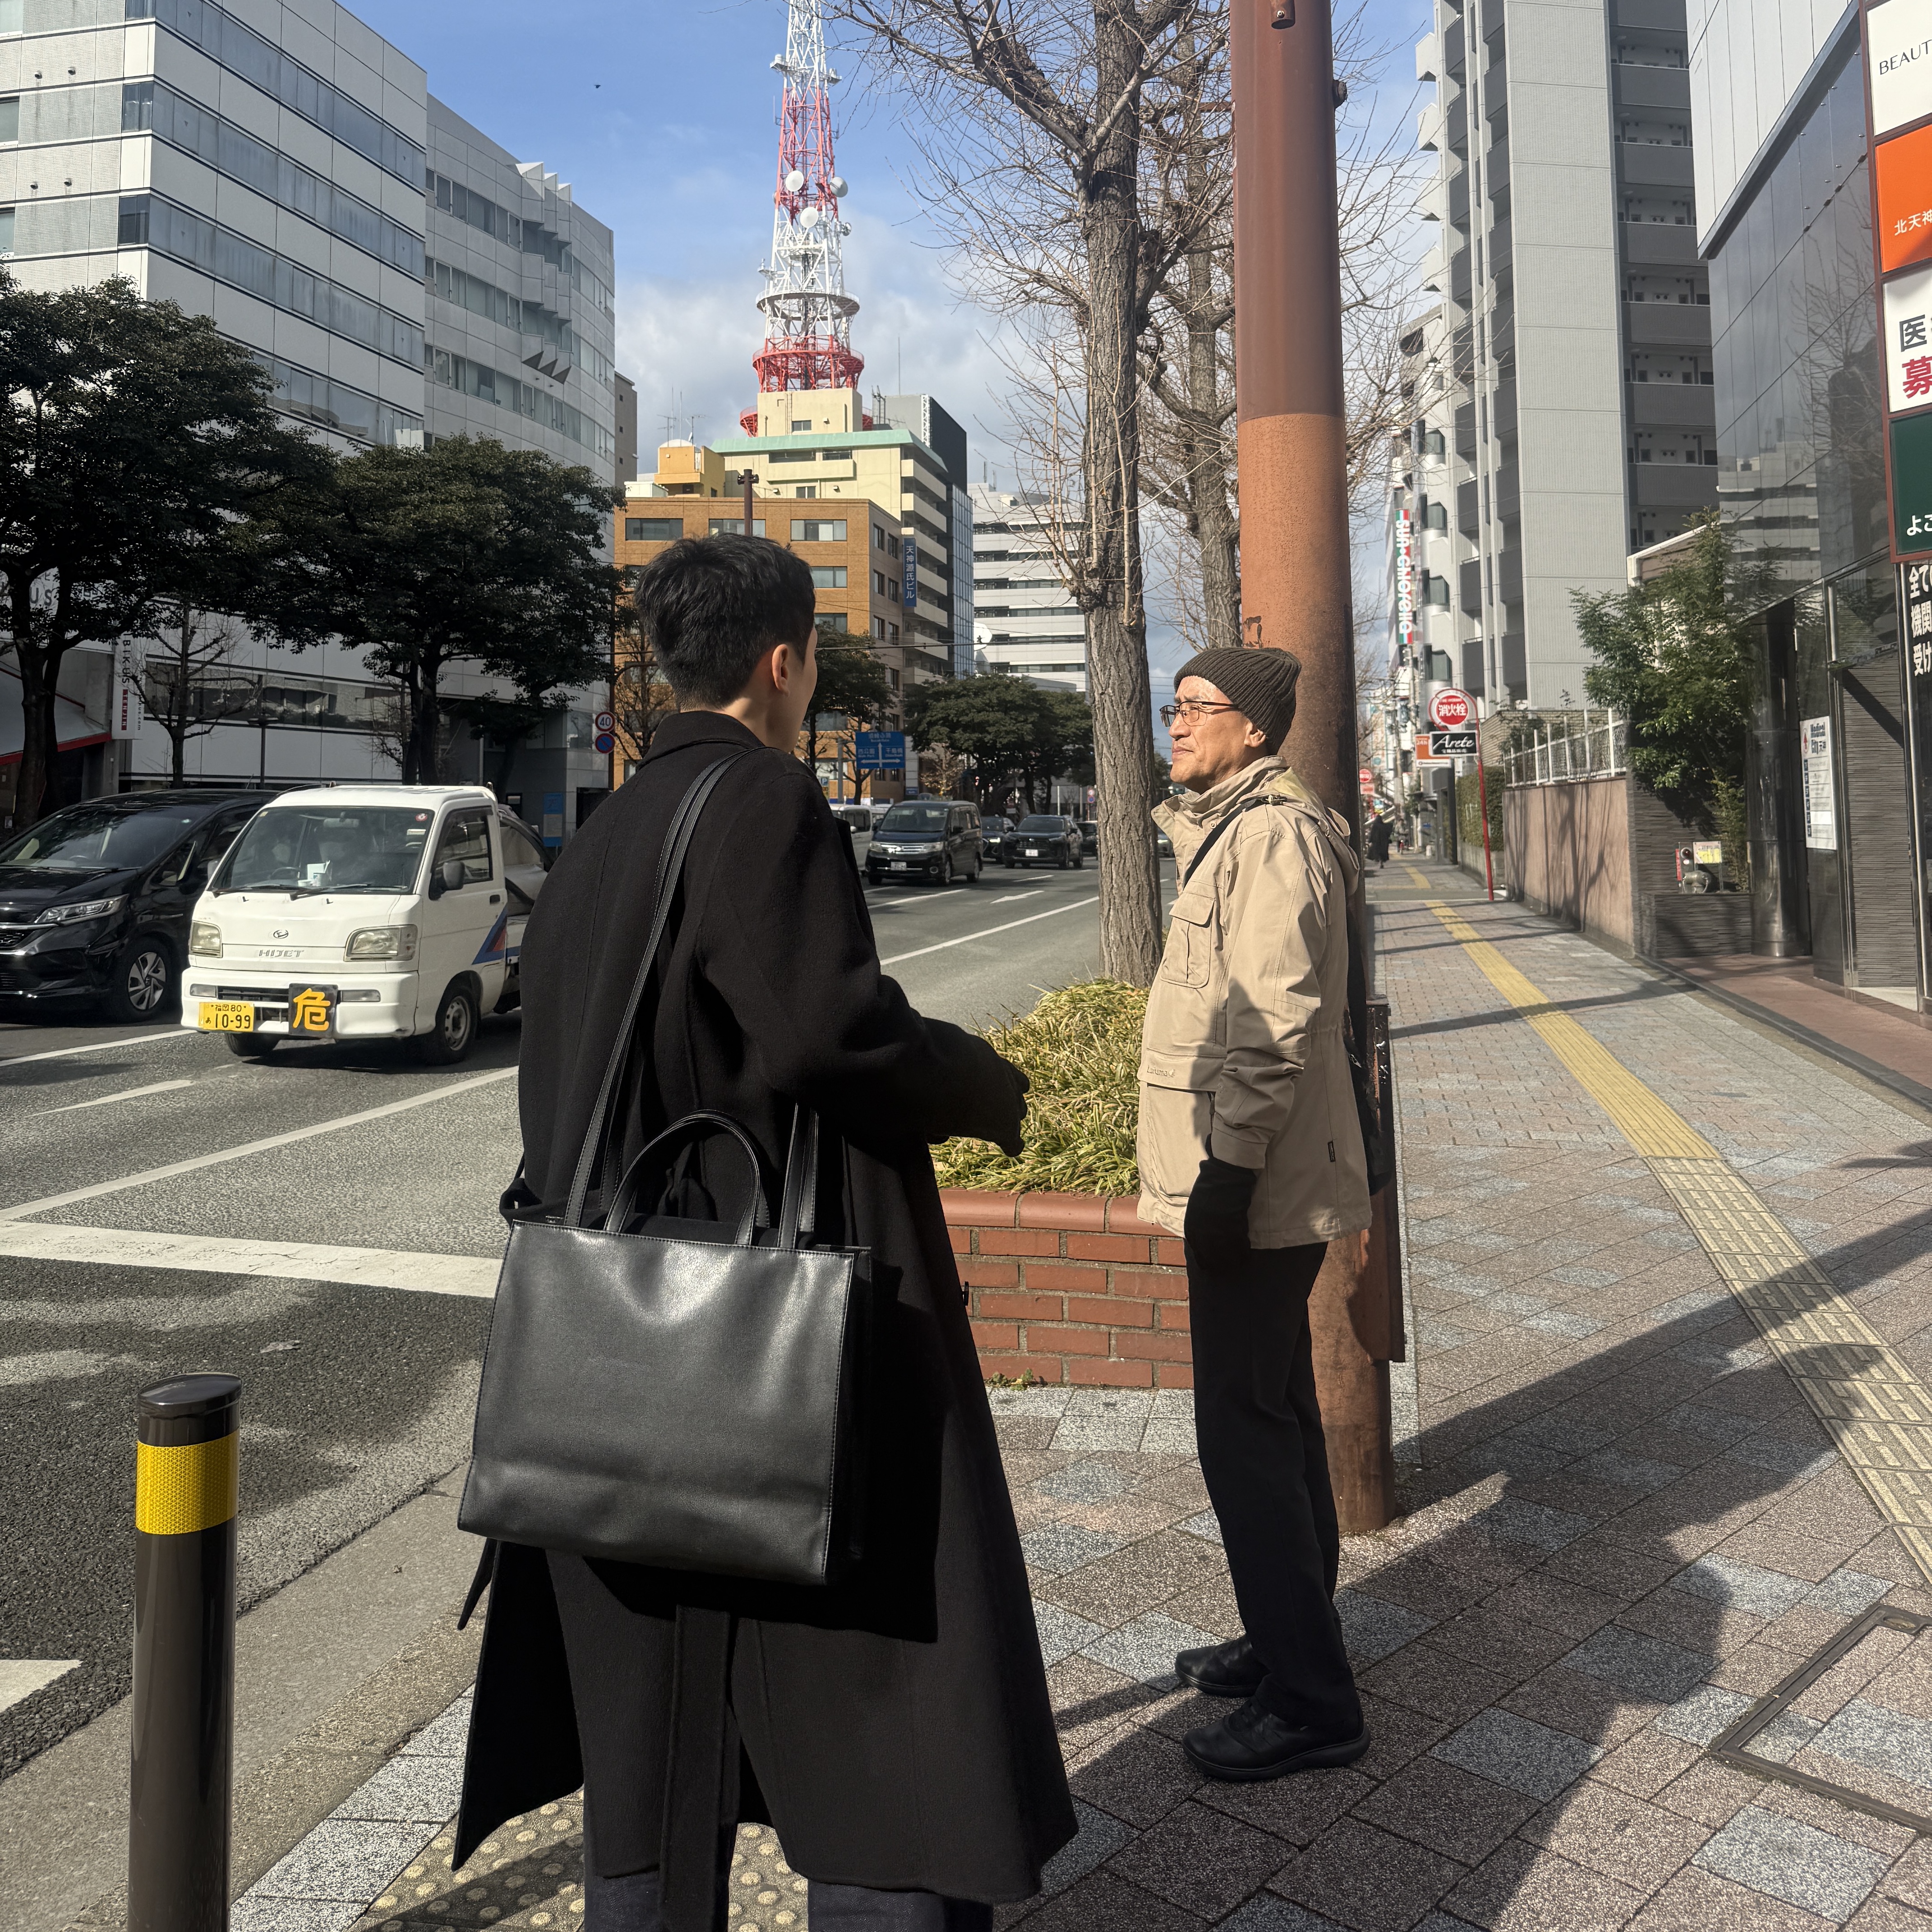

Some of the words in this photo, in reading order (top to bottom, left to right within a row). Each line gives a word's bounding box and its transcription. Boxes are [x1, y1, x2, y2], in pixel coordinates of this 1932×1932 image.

[906, 546, 914, 599] 天神源氏ビル
[1911, 600, 1932, 638] 機関
[1913, 641, 1932, 676] 受け
[1438, 703, 1467, 717] 消火栓
[600, 717, 611, 726] 40
[1433, 735, 1474, 750] Arete
[258, 949, 304, 957] HIJET
[293, 988, 331, 1030] 危
[215, 1013, 251, 1029] 10-99
